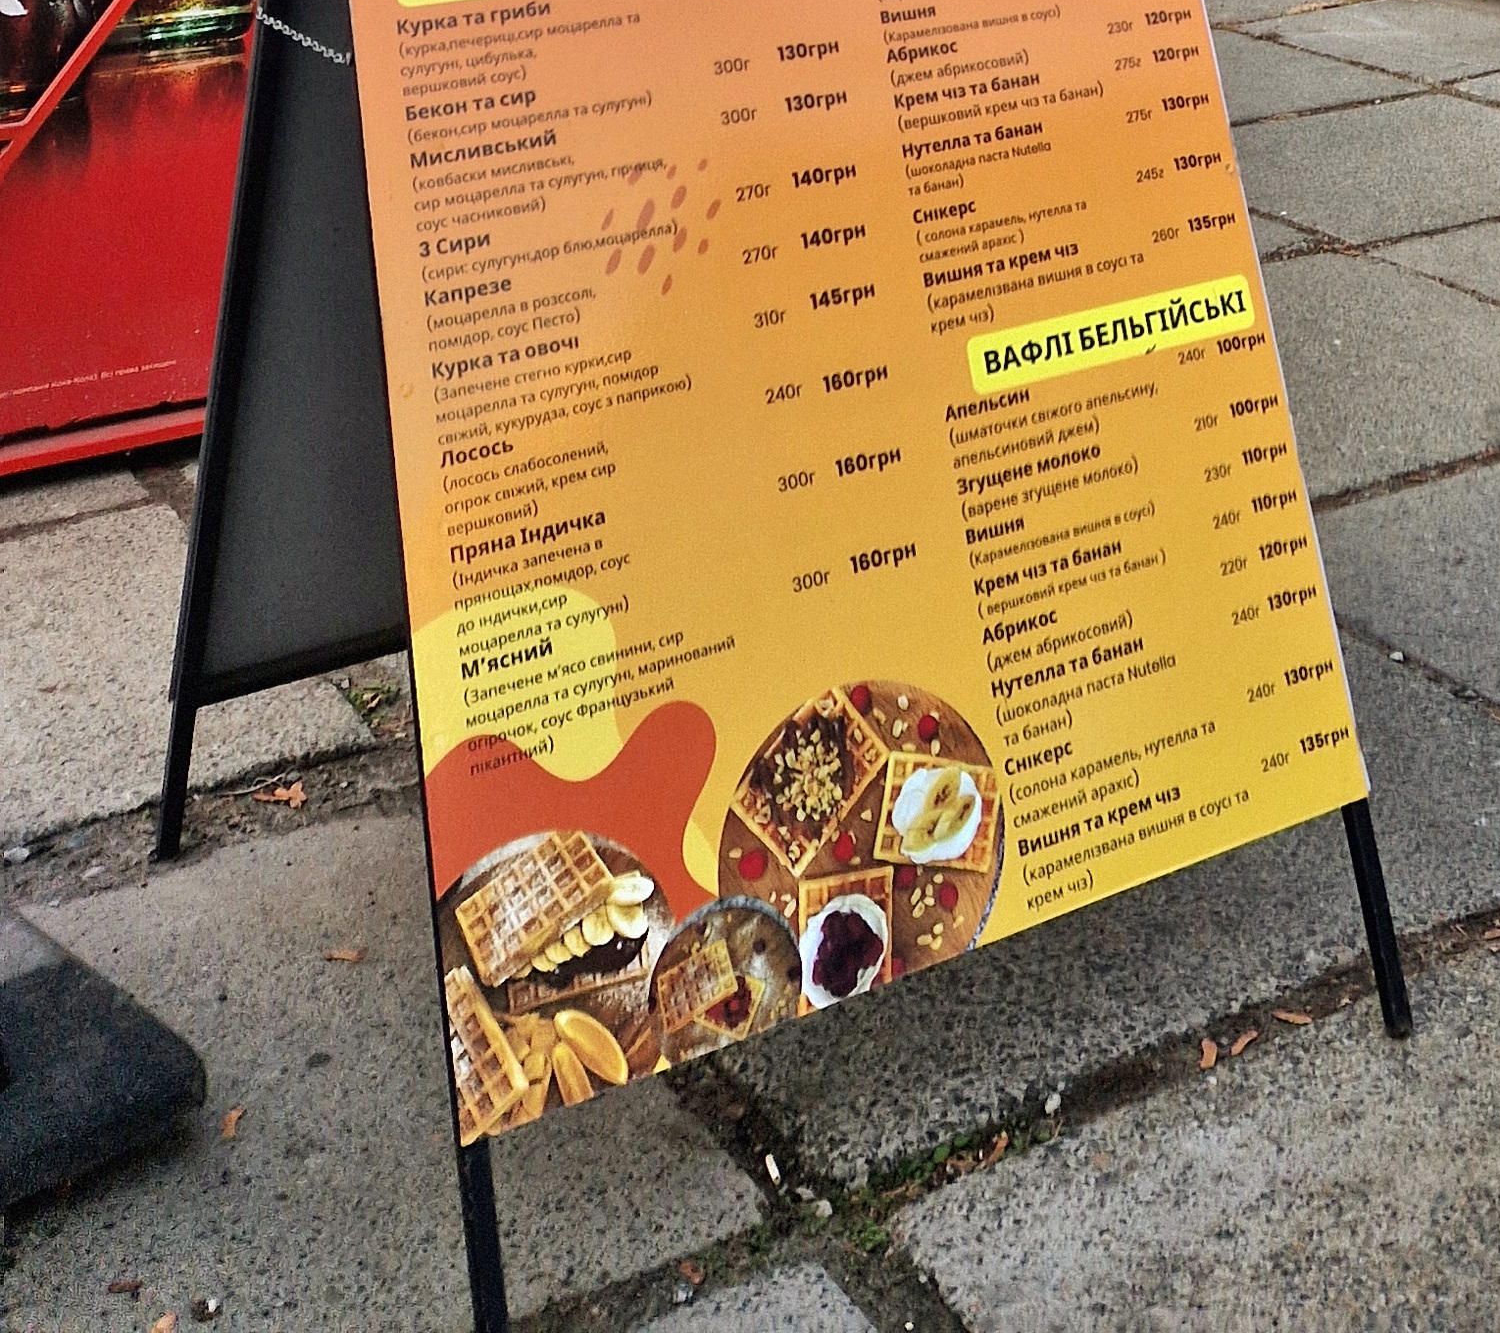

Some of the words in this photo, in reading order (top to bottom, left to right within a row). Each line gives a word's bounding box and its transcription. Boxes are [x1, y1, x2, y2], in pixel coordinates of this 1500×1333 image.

[396, 14, 459, 39] Курка
[461, 11, 486, 27] та
[489, 0, 552, 27] гриби
[879, 5, 937, 25] Вишня
[1143, 8, 1193, 27] 120грн
[776, 39, 840, 63] 130грн
[885, 40, 959, 65] Абрикос
[1151, 44, 1200, 64] 120грн
[404, 99, 469, 122] Бекон
[471, 95, 496, 112] та
[498, 89, 537, 109] сир
[783, 90, 848, 114] 130грн
[892, 89, 940, 113] Крем
[940, 85, 968, 101] чіз
[968, 81, 989, 97] та
[990, 72, 1041, 93] банан
[1160, 92, 1210, 113] 130грн
[409, 127, 558, 170] Мисливський
[900, 134, 972, 161] Нутелла
[972, 130, 993, 146] та
[993, 120, 1044, 142] банан
[790, 163, 858, 190] 140грн
[1172, 151, 1223, 172] 130грн
[911, 199, 978, 225] Снікерс
[1186, 211, 1237, 233] 135грн
[435, 232, 491, 256] Сири
[799, 223, 867, 250] 140грн
[922, 262, 984, 289] Вишня
[984, 258, 1007, 275] та
[1007, 247, 1053, 272] крем
[1053, 242, 1080, 259] чіз
[423, 277, 513, 308] Капрезе
[808, 282, 876, 311] 145грн
[982, 329, 1076, 377] ВАФЛІ
[1077, 288, 1248, 353] БЕЛЬГІЙСЬКІ
[431, 353, 494, 382] Курка
[496, 347, 521, 365] та
[524, 335, 580, 359] овочі
[821, 363, 889, 394] 160грн
[944, 386, 1031, 424] Апельсин
[439, 439, 515, 470] Лосось
[834, 446, 902, 478] 160грн
[955, 460, 1034, 497] Згущене
[1035, 443, 1102, 475] молоко
[449, 533, 517, 566] Пряна
[519, 510, 607, 547] Індичка
[964, 515, 1026, 546] Вишня
[849, 541, 918, 575] 160грн
[972, 569, 1021, 599] Крем
[1021, 561, 1048, 581] чіз
[1048, 554, 1070, 574] та
[1071, 538, 1123, 567] банан
[981, 608, 1059, 647] Абрикос
[990, 661, 1067, 700] Нутелла
[1067, 653, 1090, 674] та
[1090, 636, 1145, 666] банан
[1003, 740, 1074, 777] Снікерс
[1016, 821, 1082, 858] Вишня
[1082, 813, 1105, 833] та
[1106, 794, 1154, 827] крем
[1154, 785, 1182, 806] чіз
